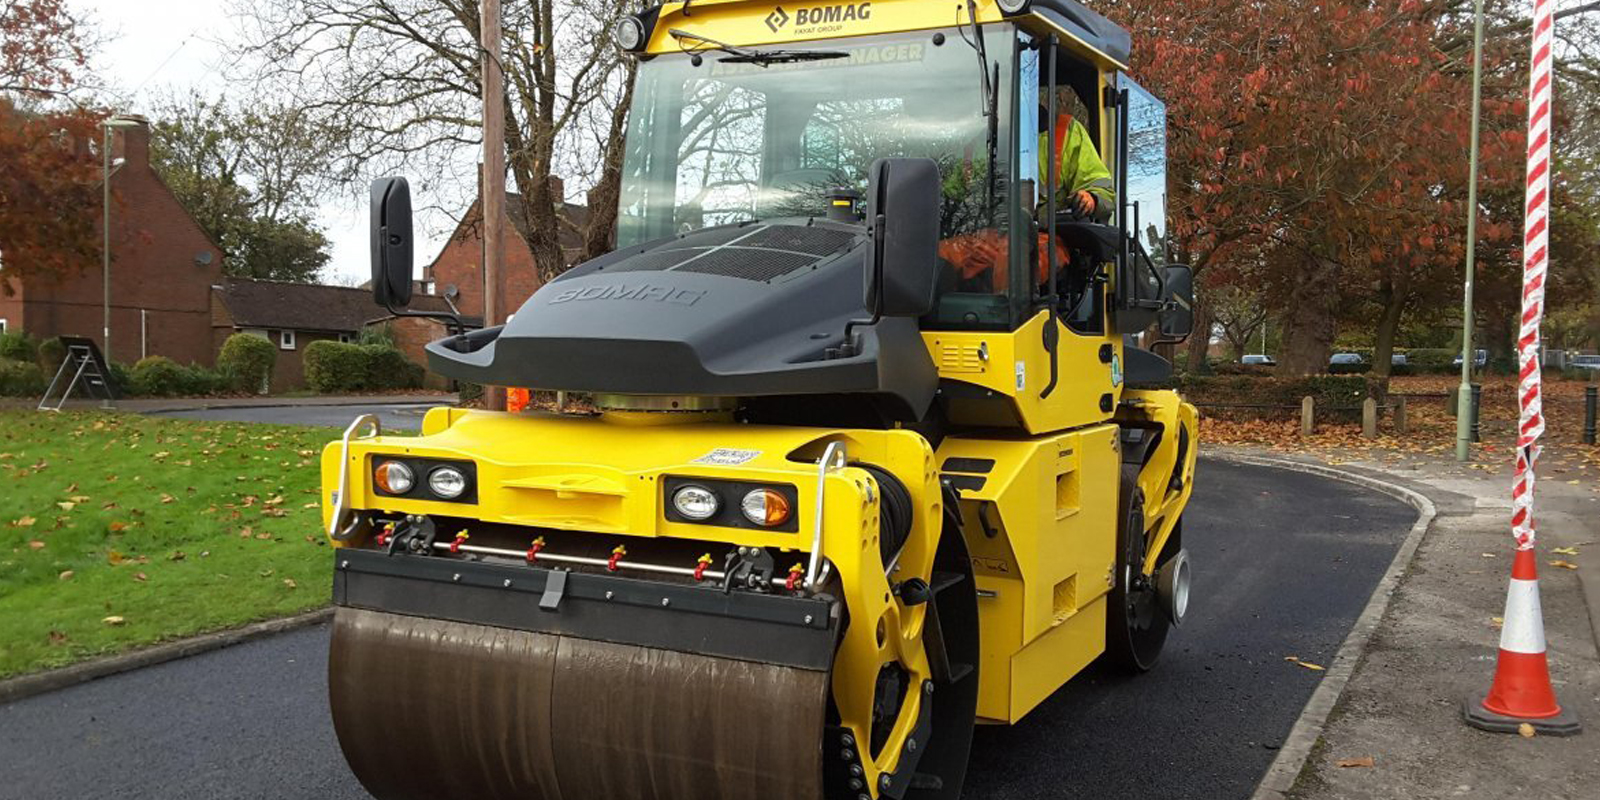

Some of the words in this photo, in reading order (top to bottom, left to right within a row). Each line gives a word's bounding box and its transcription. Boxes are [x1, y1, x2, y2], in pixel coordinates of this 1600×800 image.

[795, 2, 871, 26] BOMAG
[817, 25, 843, 33] GROUP
[548, 283, 711, 307] BOMAG
